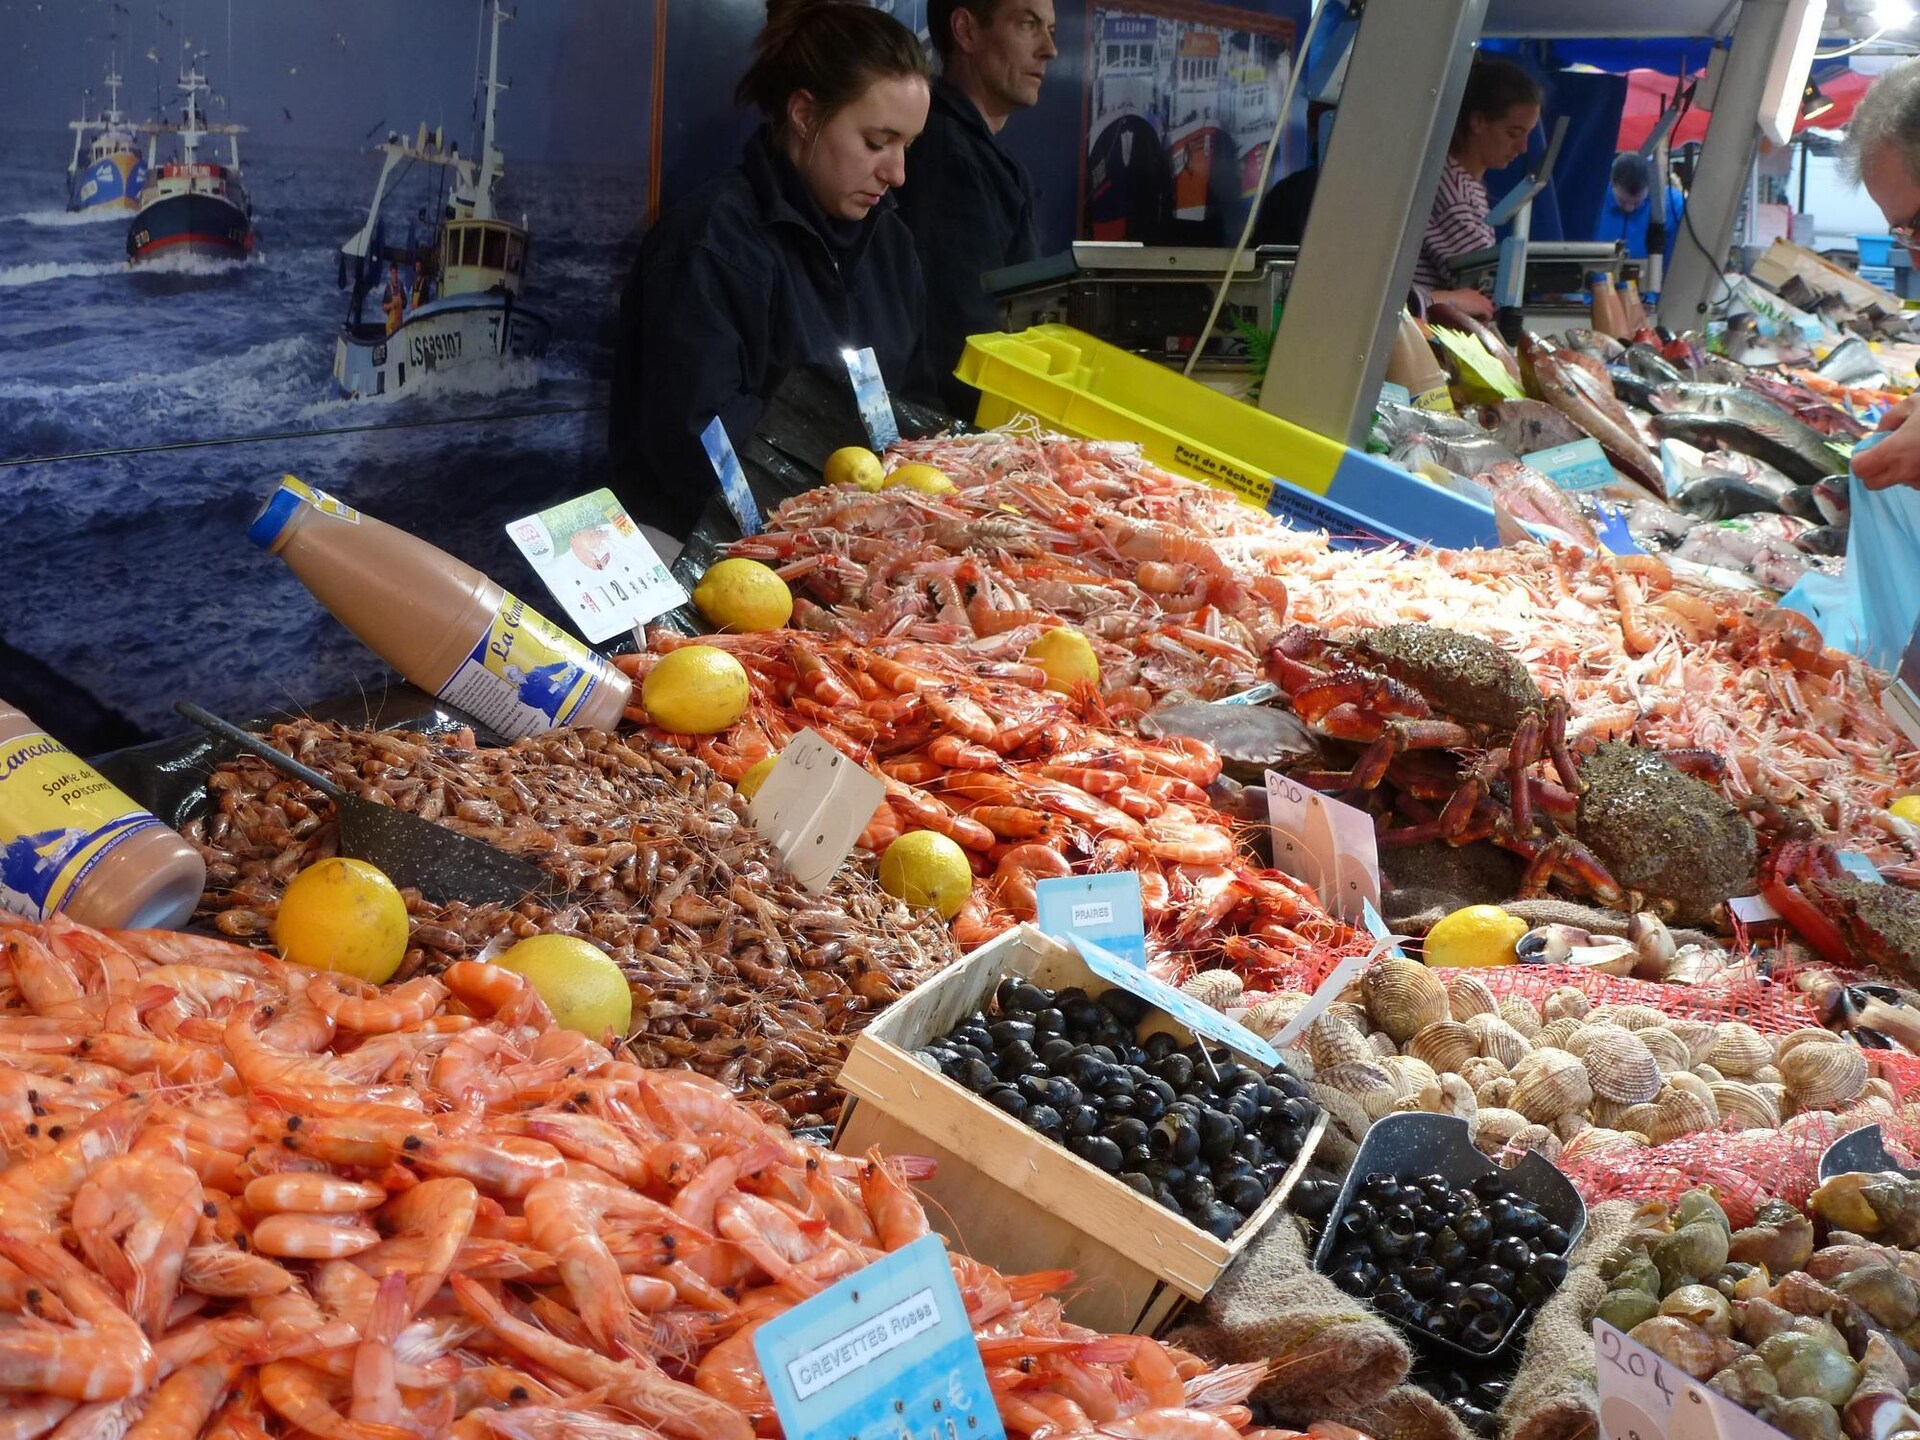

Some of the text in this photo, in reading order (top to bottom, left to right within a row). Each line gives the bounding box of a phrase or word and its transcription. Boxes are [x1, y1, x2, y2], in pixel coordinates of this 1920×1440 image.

[1175, 445, 1200, 463] Port
[1202, 458, 1217, 470] de
[1219, 464, 1254, 486] Pêche
[1256, 481, 1271, 495] de
[1273, 488, 1314, 514] Lorient
[490, 630, 515, 663] La
[1074, 907, 1110, 921] PRAIRES
[799, 1303, 933, 1386] CREVETTES Roses
[1600, 1330, 1675, 1407] 204
